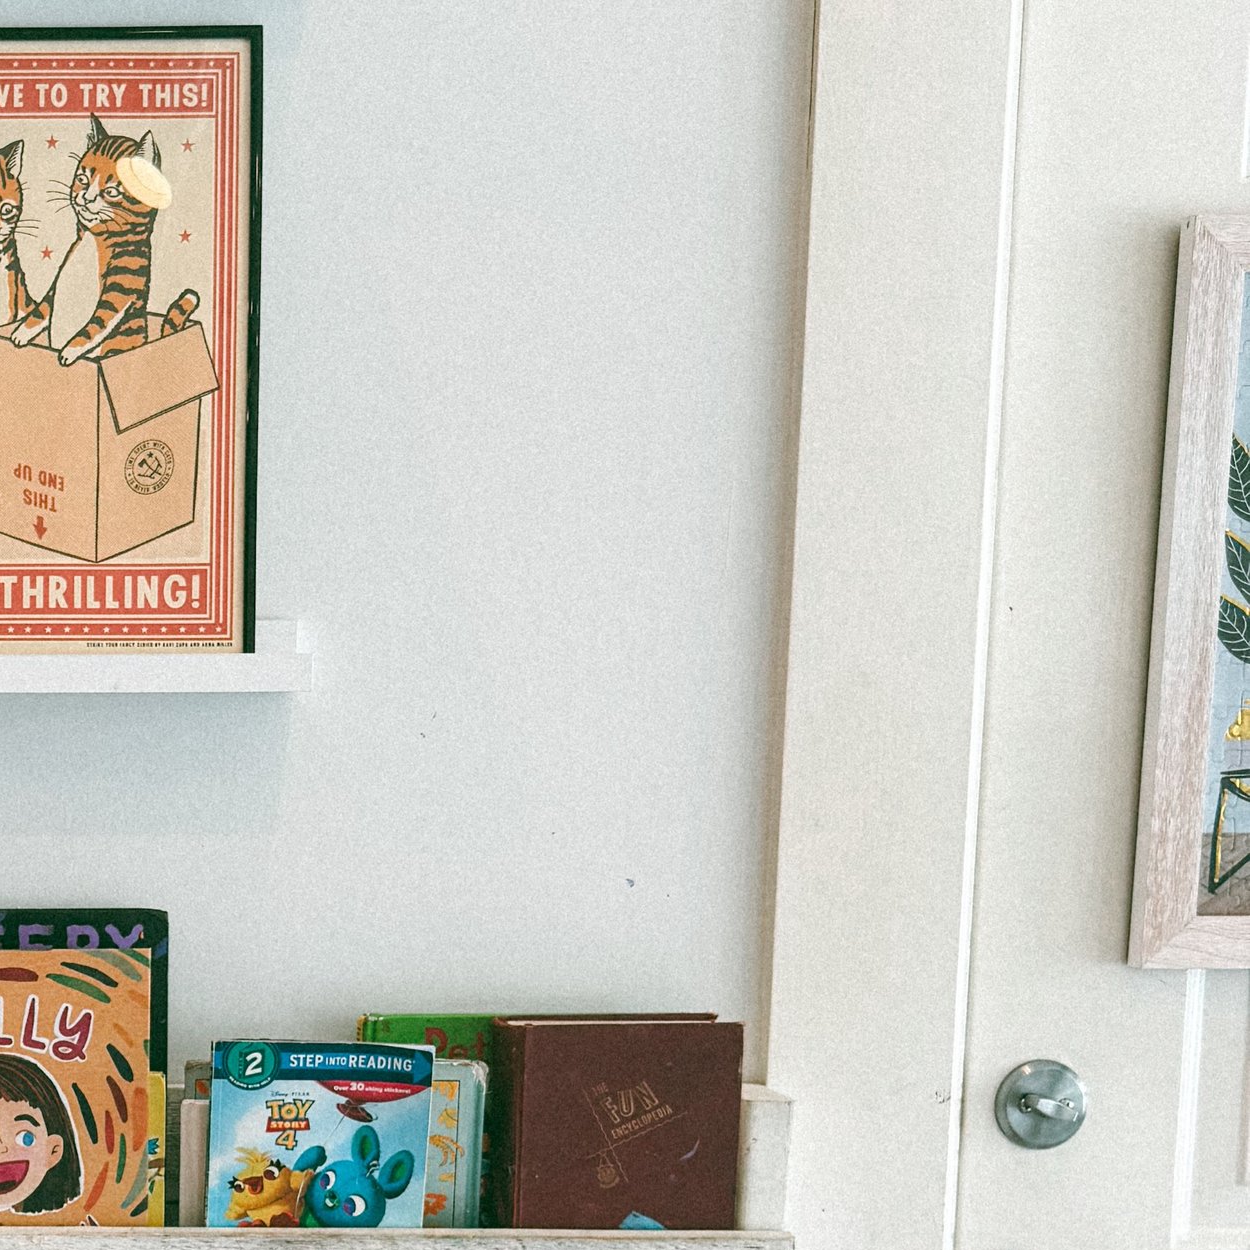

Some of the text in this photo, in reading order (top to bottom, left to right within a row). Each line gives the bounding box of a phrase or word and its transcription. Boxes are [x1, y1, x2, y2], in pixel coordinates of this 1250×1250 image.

[36, 83, 68, 108] TO
[80, 83, 125, 108] TRY
[139, 83, 209, 108] THIS!
[13, 463, 64, 491] END UP
[23, 488, 57, 512] THIS
[245, 1052, 263, 1076] 2
[289, 1054, 413, 1072] STEP INTO READING
[350, 1082, 365, 1091] 30
[592, 1082, 609, 1097] THE
[600, 1080, 659, 1123] FUN
[269, 1120, 307, 1129] STORY
[611, 1104, 673, 1139] ENCYCLOPEDIA
[275, 1129, 298, 1150] 4
